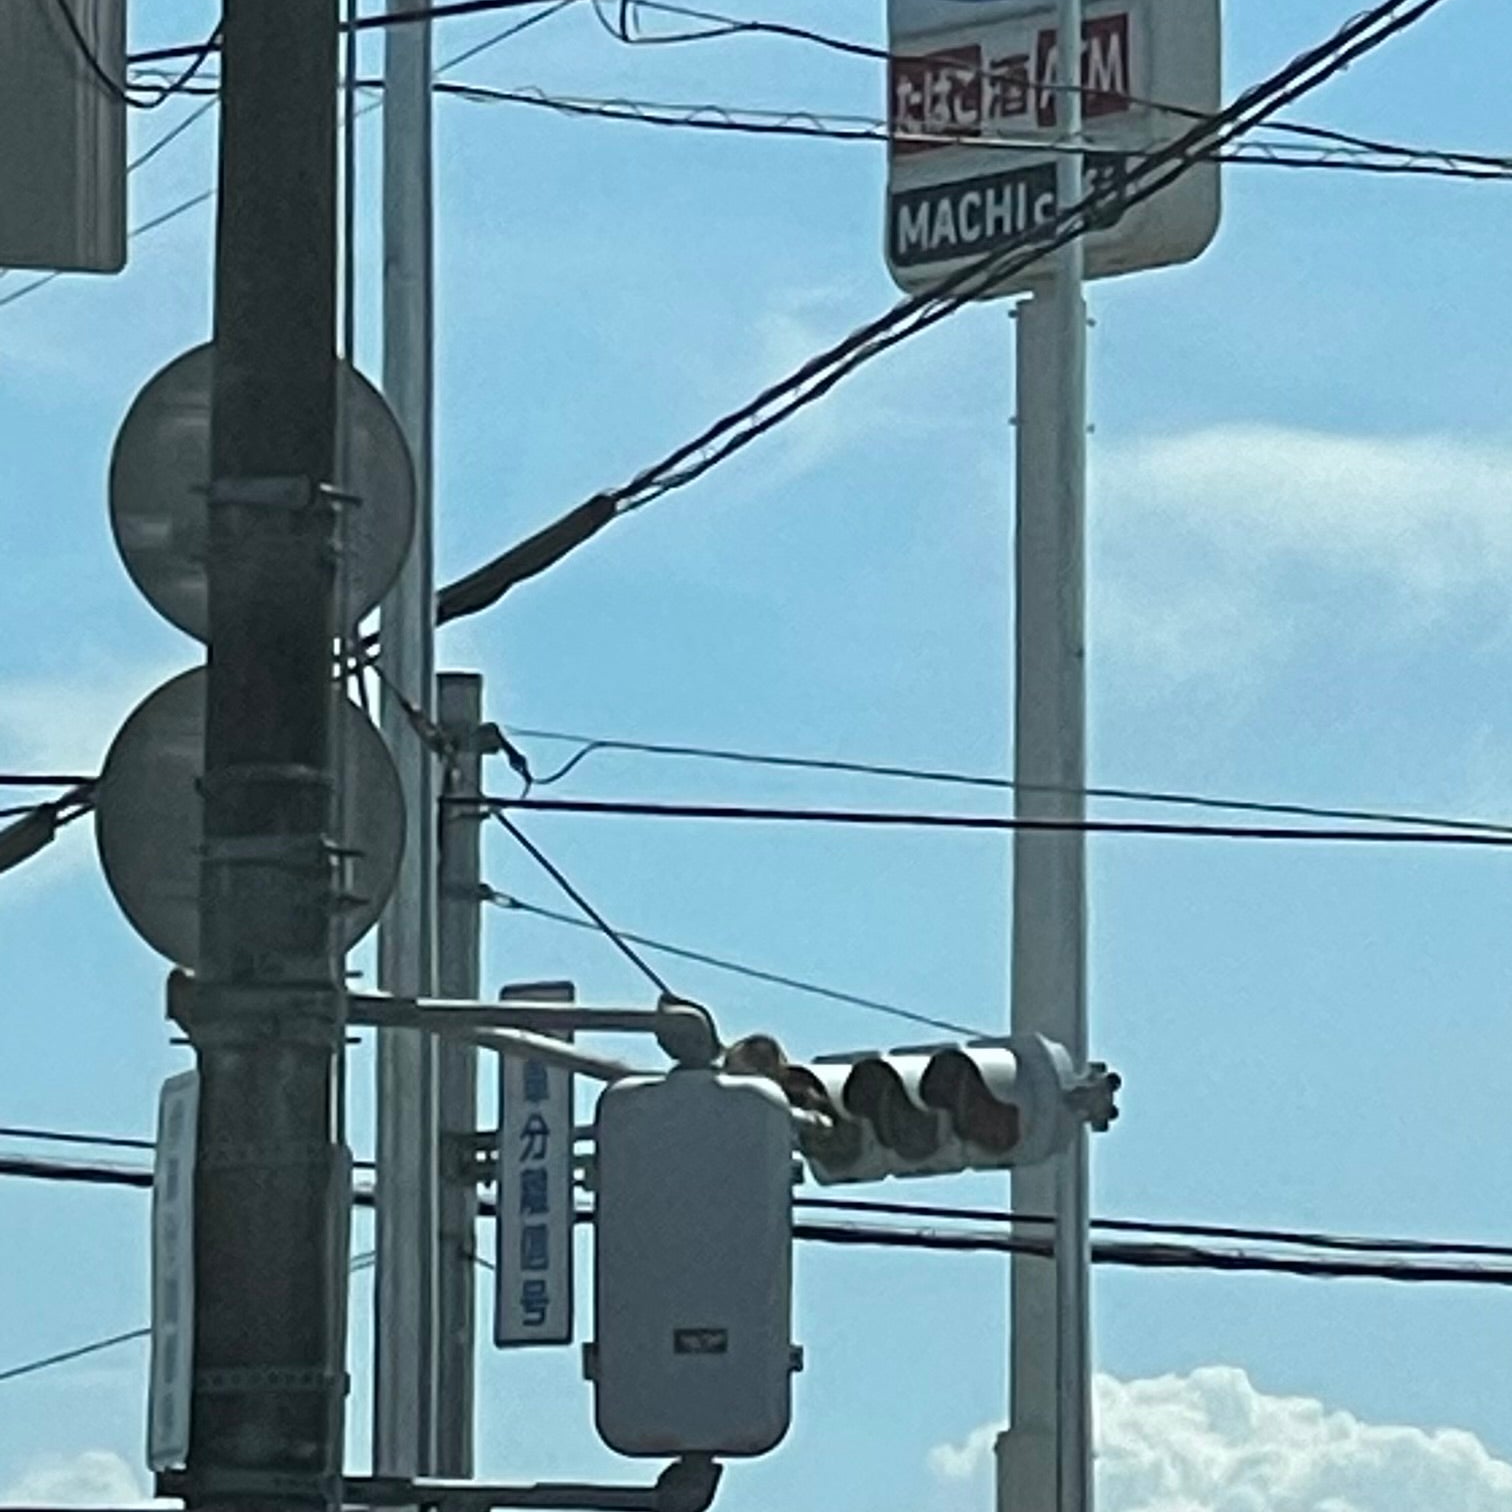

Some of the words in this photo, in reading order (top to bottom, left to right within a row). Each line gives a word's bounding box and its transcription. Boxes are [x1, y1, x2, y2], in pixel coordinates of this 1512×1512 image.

[897, 67, 979, 133] たばこ
[1039, 32, 1126, 110] AM
[899, 182, 1027, 255] MACHI
